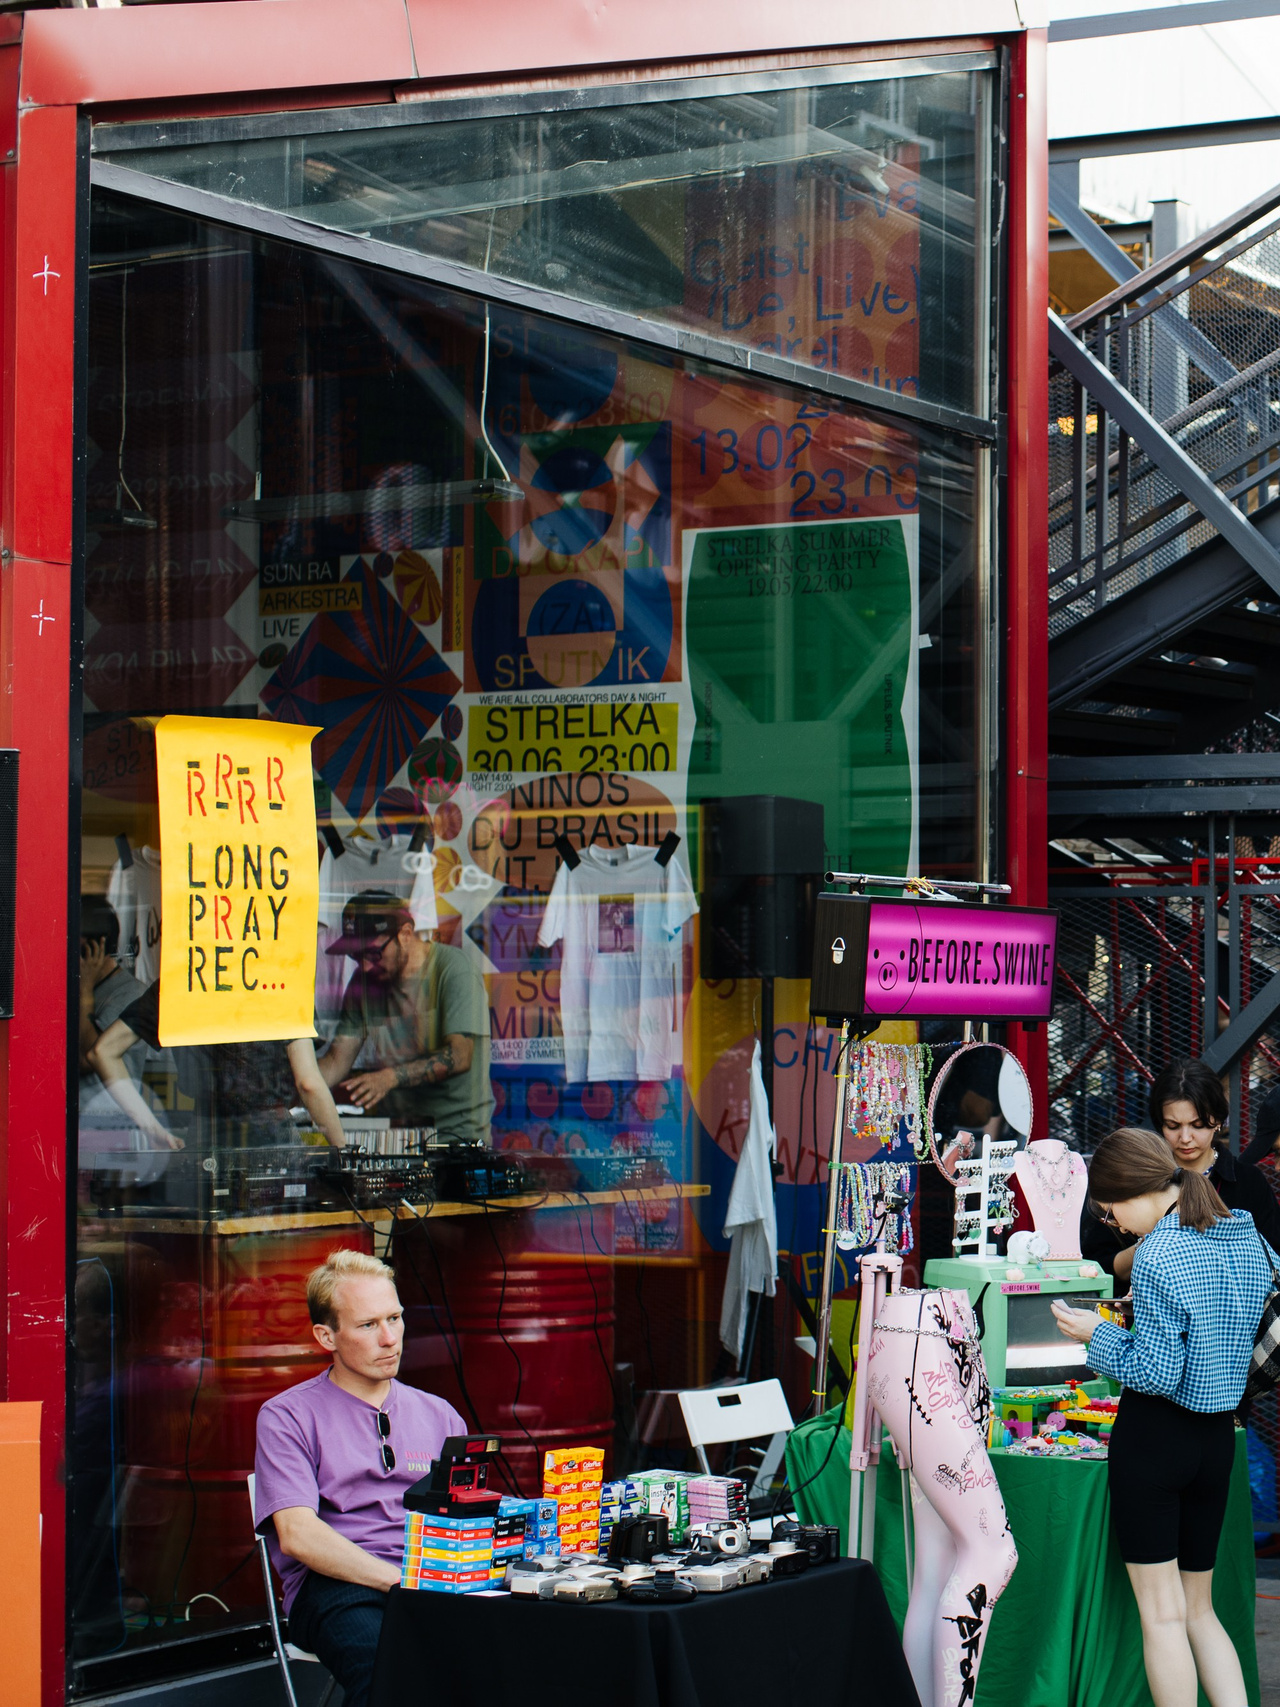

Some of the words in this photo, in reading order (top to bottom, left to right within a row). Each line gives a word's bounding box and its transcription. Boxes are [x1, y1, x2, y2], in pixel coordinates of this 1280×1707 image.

[707, 534, 793, 559] STRELKA
[799, 527, 893, 551] SUMMER
[262, 562, 299, 584] SUN
[307, 561, 333, 581] RA
[716, 554, 811, 579] OPENING
[816, 549, 881, 574] PARTY
[262, 585, 360, 613] ARKESTRA
[748, 572, 853, 598] 19.05/22:00
[262, 617, 300, 639] LIVE
[493, 645, 651, 689] SPUTNIK
[479, 695, 493, 705] WE
[495, 694, 513, 704] ARE
[514, 694, 530, 704] ALL
[531, 692, 609, 704] COLLABORATORS
[610, 692, 630, 702] DAY
[638, 691, 667, 702] NIGHT
[485, 703, 660, 743] STRELKA
[471, 773, 489, 782] DAY
[491, 772, 513, 782] 14:00
[472, 815, 522, 851] DU
[537, 810, 671, 850] BRASIL
[187, 842, 290, 891] LONG
[188, 894, 289, 942] PRAY
[907, 937, 1051, 986] BEFORE.SWINE
